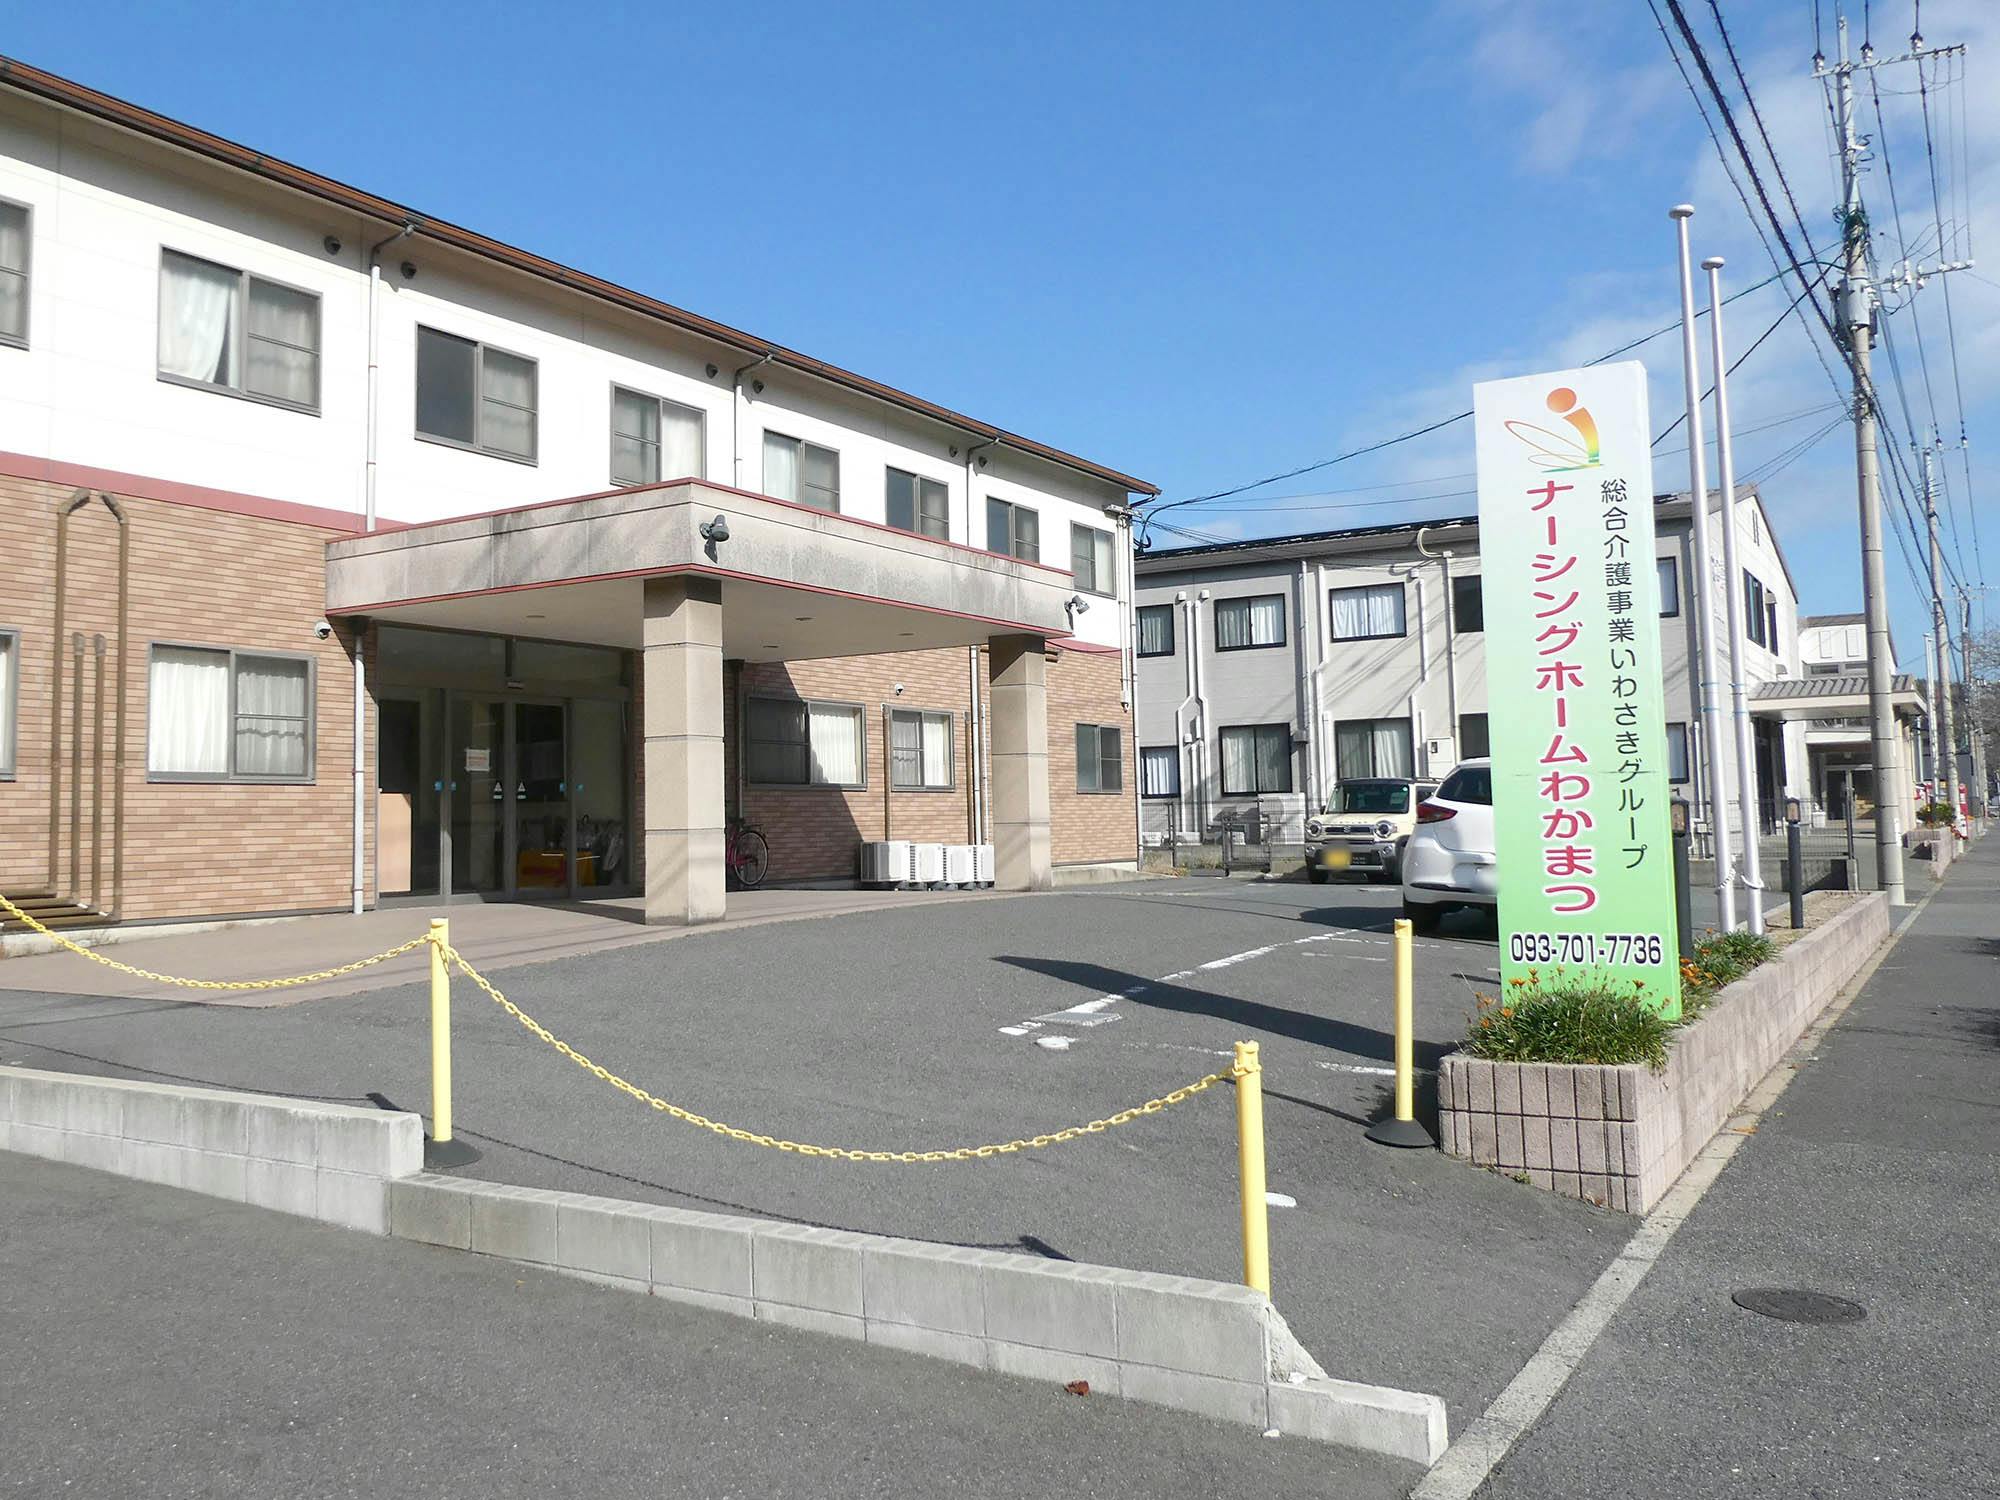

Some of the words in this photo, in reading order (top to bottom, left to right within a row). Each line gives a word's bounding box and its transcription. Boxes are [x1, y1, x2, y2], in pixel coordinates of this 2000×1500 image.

[1526, 480, 1597, 912] ナーシングホームわかまつ
[1600, 477, 1648, 869] 総合介護事業いわさきグループ
[1511, 934, 1661, 964] 093-701-7736
